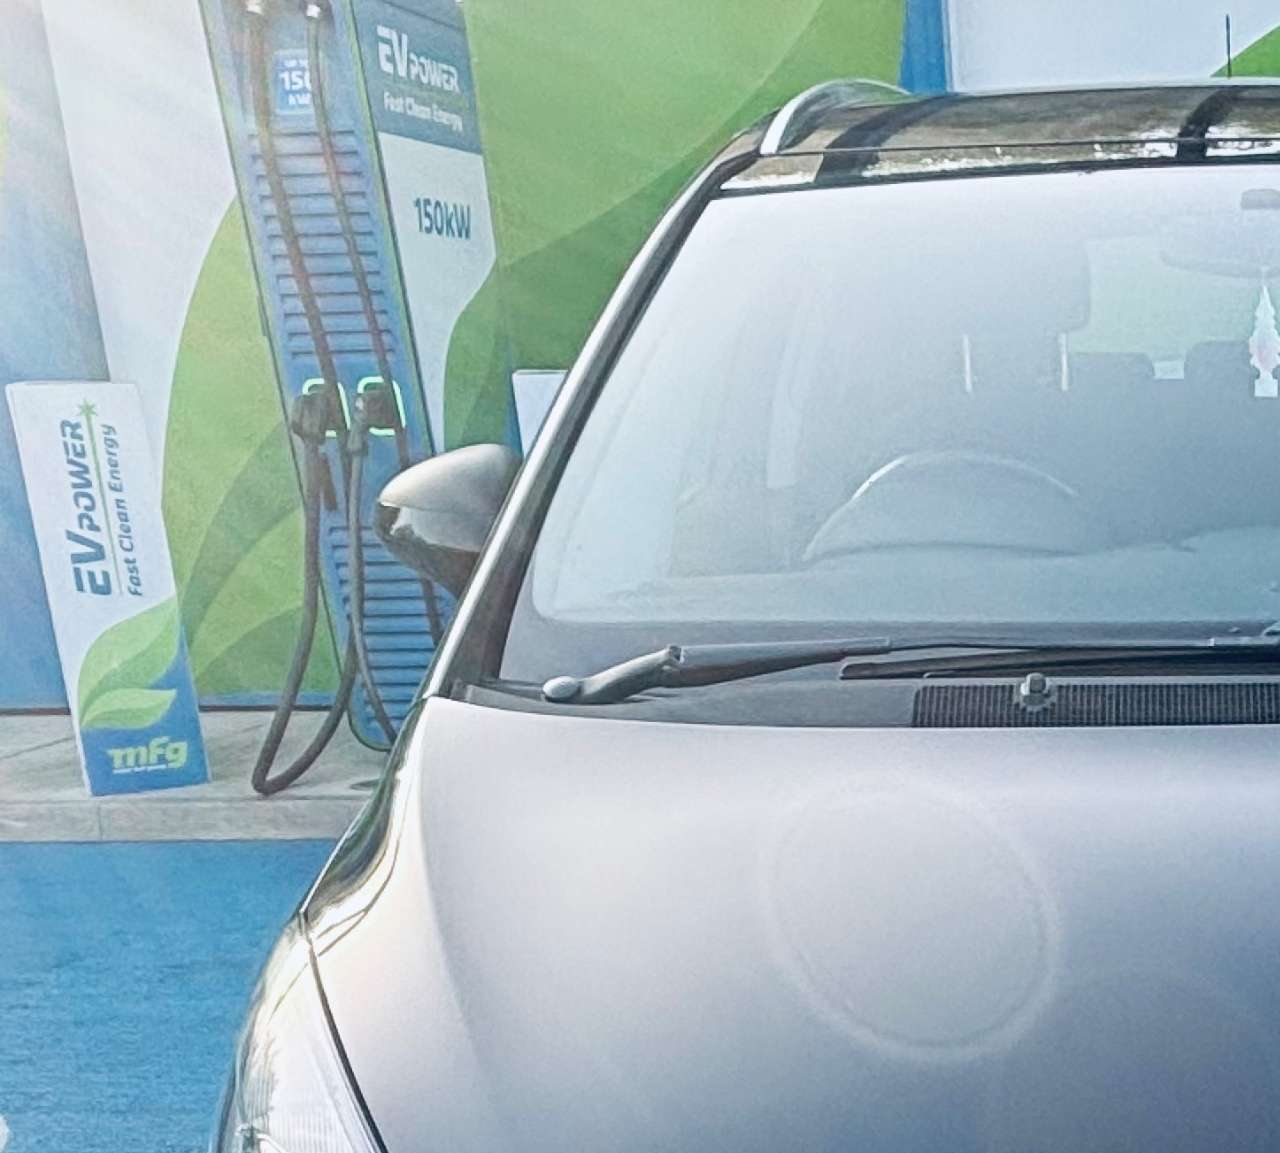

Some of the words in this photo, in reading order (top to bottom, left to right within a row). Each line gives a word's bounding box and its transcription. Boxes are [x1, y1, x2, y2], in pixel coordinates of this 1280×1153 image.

[383, 91, 404, 111] Fast
[405, 97, 431, 122] Clean
[431, 105, 463, 132] Energy
[413, 198, 470, 240] 150kW
[101, 424, 123, 492] Energy
[115, 498, 134, 552] Clean
[126, 557, 143, 597] Fast
[106, 736, 188, 769] mfg
